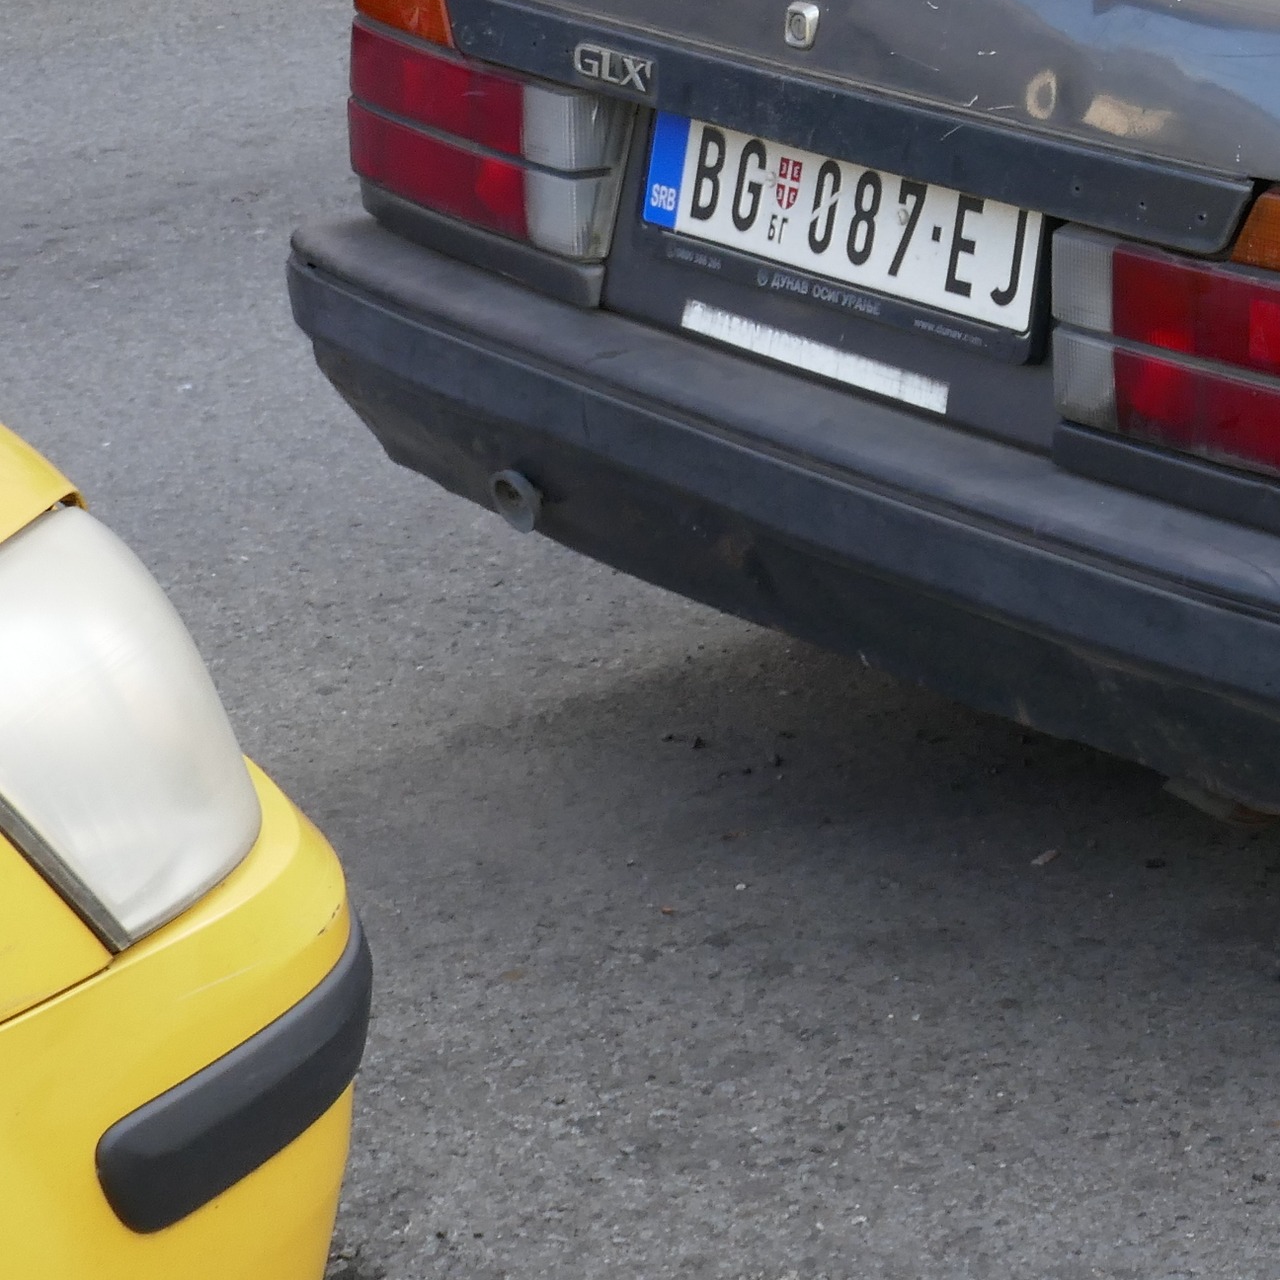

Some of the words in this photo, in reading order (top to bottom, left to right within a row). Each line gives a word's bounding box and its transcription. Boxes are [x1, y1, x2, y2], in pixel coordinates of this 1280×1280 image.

[574, 43, 654, 93] GLX
[690, 125, 768, 232] BG
[651, 184, 677, 211] SRB
[767, 213, 788, 245] БГ
[771, 272, 809, 296] ДУНАВ
